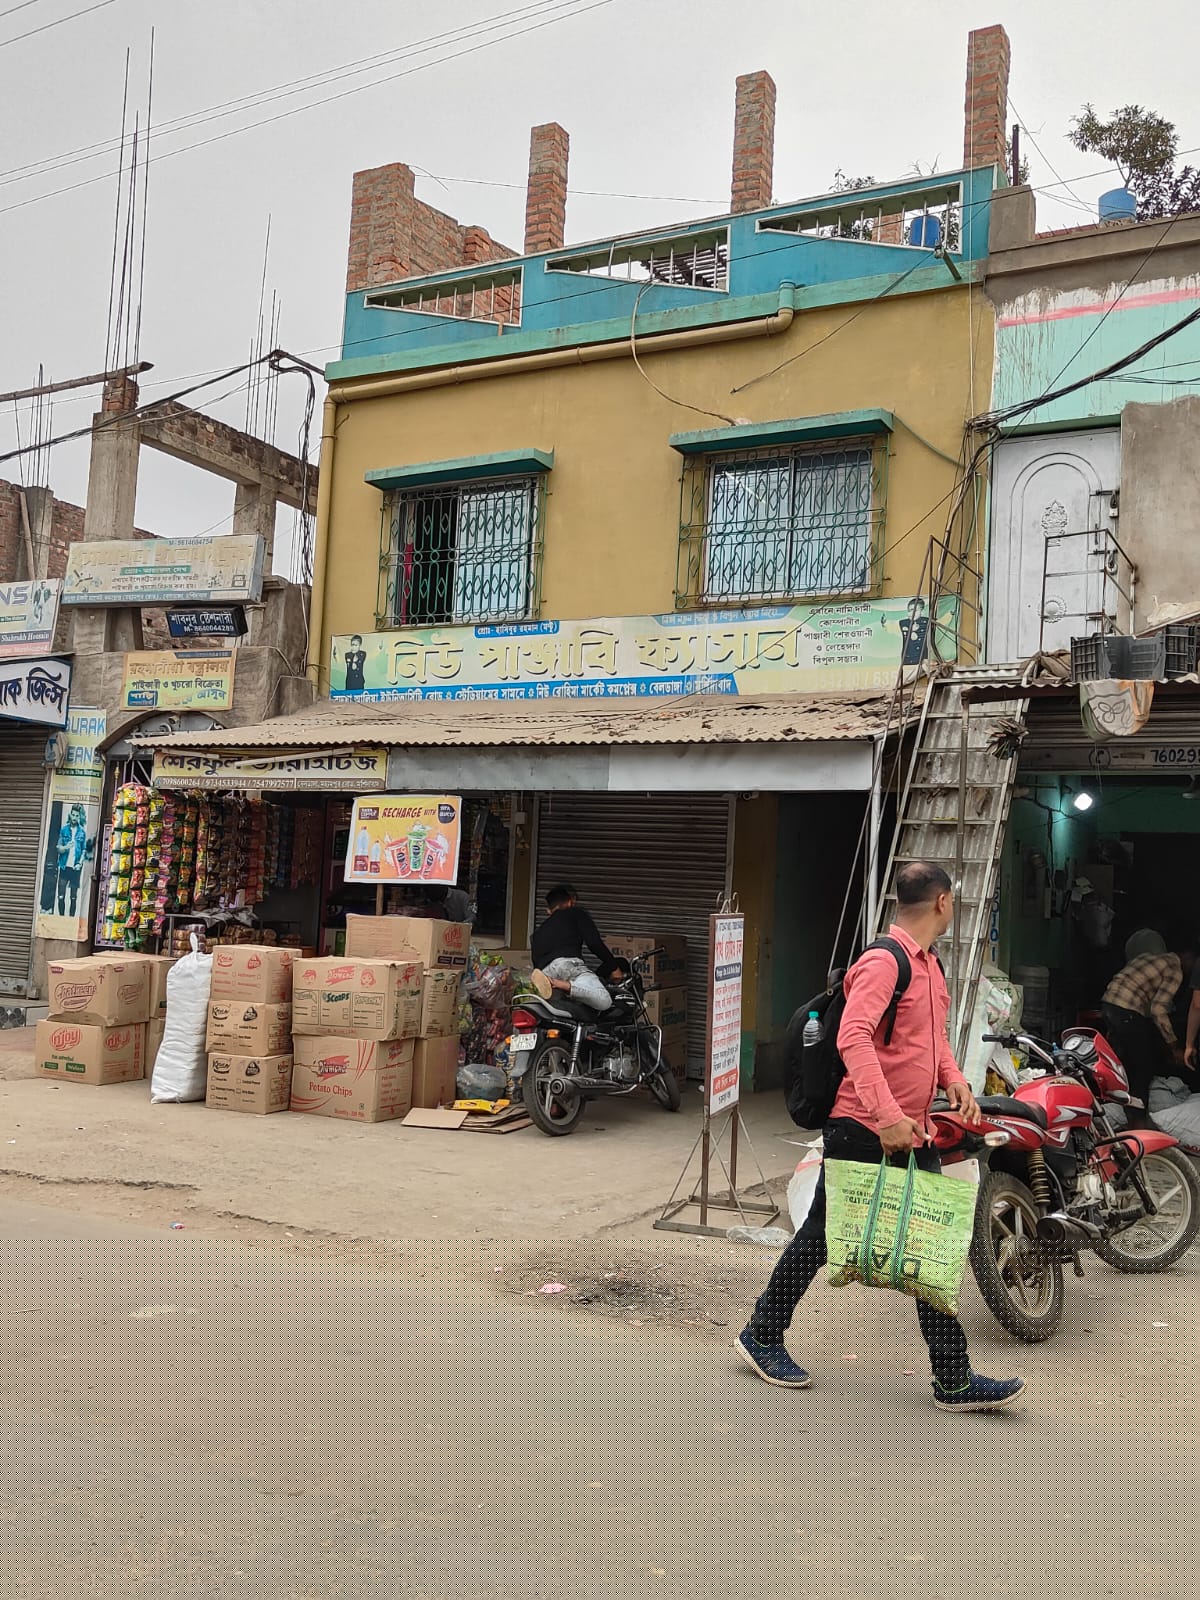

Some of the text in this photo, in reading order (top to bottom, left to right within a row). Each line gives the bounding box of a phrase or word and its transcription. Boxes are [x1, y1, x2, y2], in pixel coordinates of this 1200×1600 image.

[819, 616, 859, 627] কোম্পানীর
[834, 627, 873, 639] শেরওয়ানী
[387, 640, 463, 686] নিউ
[478, 630, 619, 681] পাঞ্জাবি
[812, 654, 835, 665] বিপুল
[0, 677, 22, 706] াক
[501, 686, 525, 700] সামনে
[535, 682, 549, 697] নিউ
[581, 680, 605, 696] মার্কেট
[1151, 748, 1200, 763] 76029
[382, 807, 423, 819] RECHARGE
[309, 1081, 353, 1097] Potato Chips
